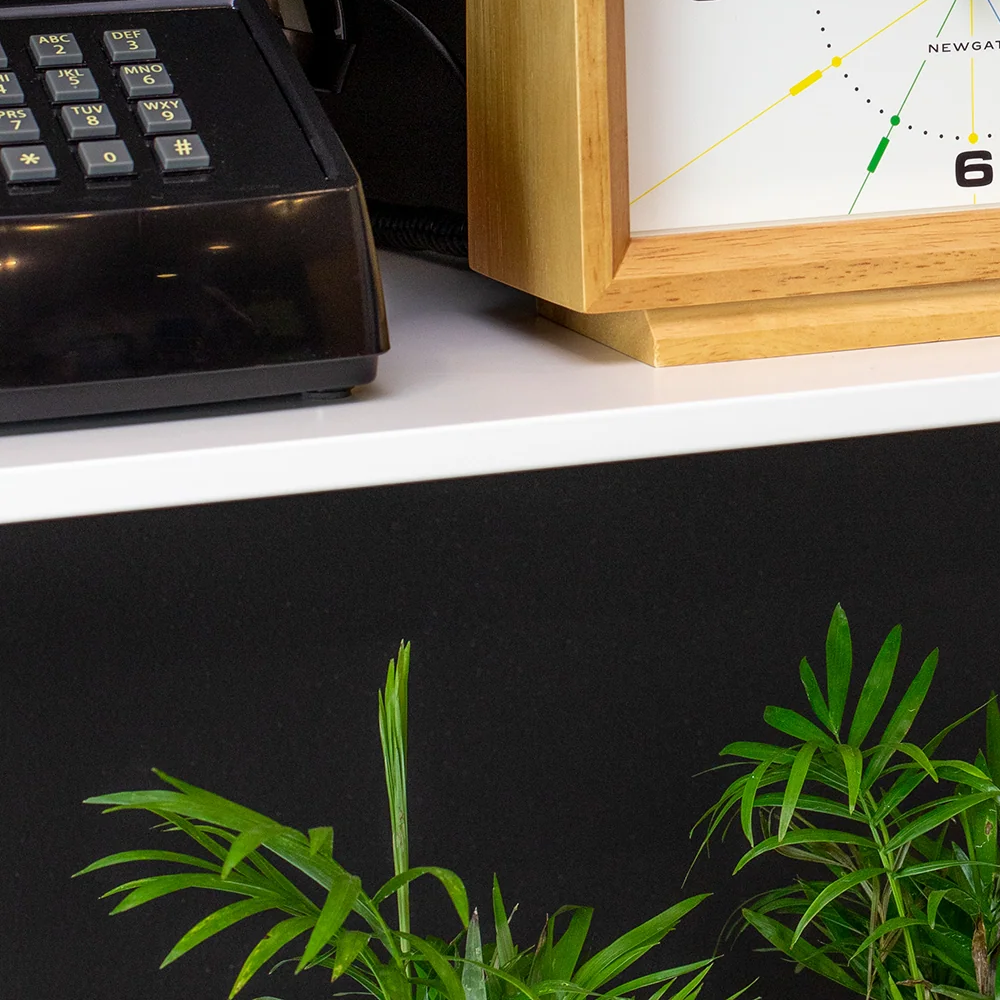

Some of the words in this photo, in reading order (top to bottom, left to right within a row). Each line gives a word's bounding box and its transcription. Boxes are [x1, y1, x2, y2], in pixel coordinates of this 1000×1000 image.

[39, 34, 71, 44] ABC
[111, 30, 142, 41] DEF
[54, 45, 67, 55] 2
[126, 40, 139, 50] 3
[58, 68, 84, 78] JKL
[124, 64, 163, 74] MNO
[68, 76, 80, 86] 5
[143, 75, 156, 85] 6
[70, 105, 103, 115] TUV
[143, 100, 179, 111] WXY
[86, 115, 100, 126] 8
[161, 110, 175, 121] 9
[10, 119, 22, 130] 7
[955, 150, 994, 188] 6
